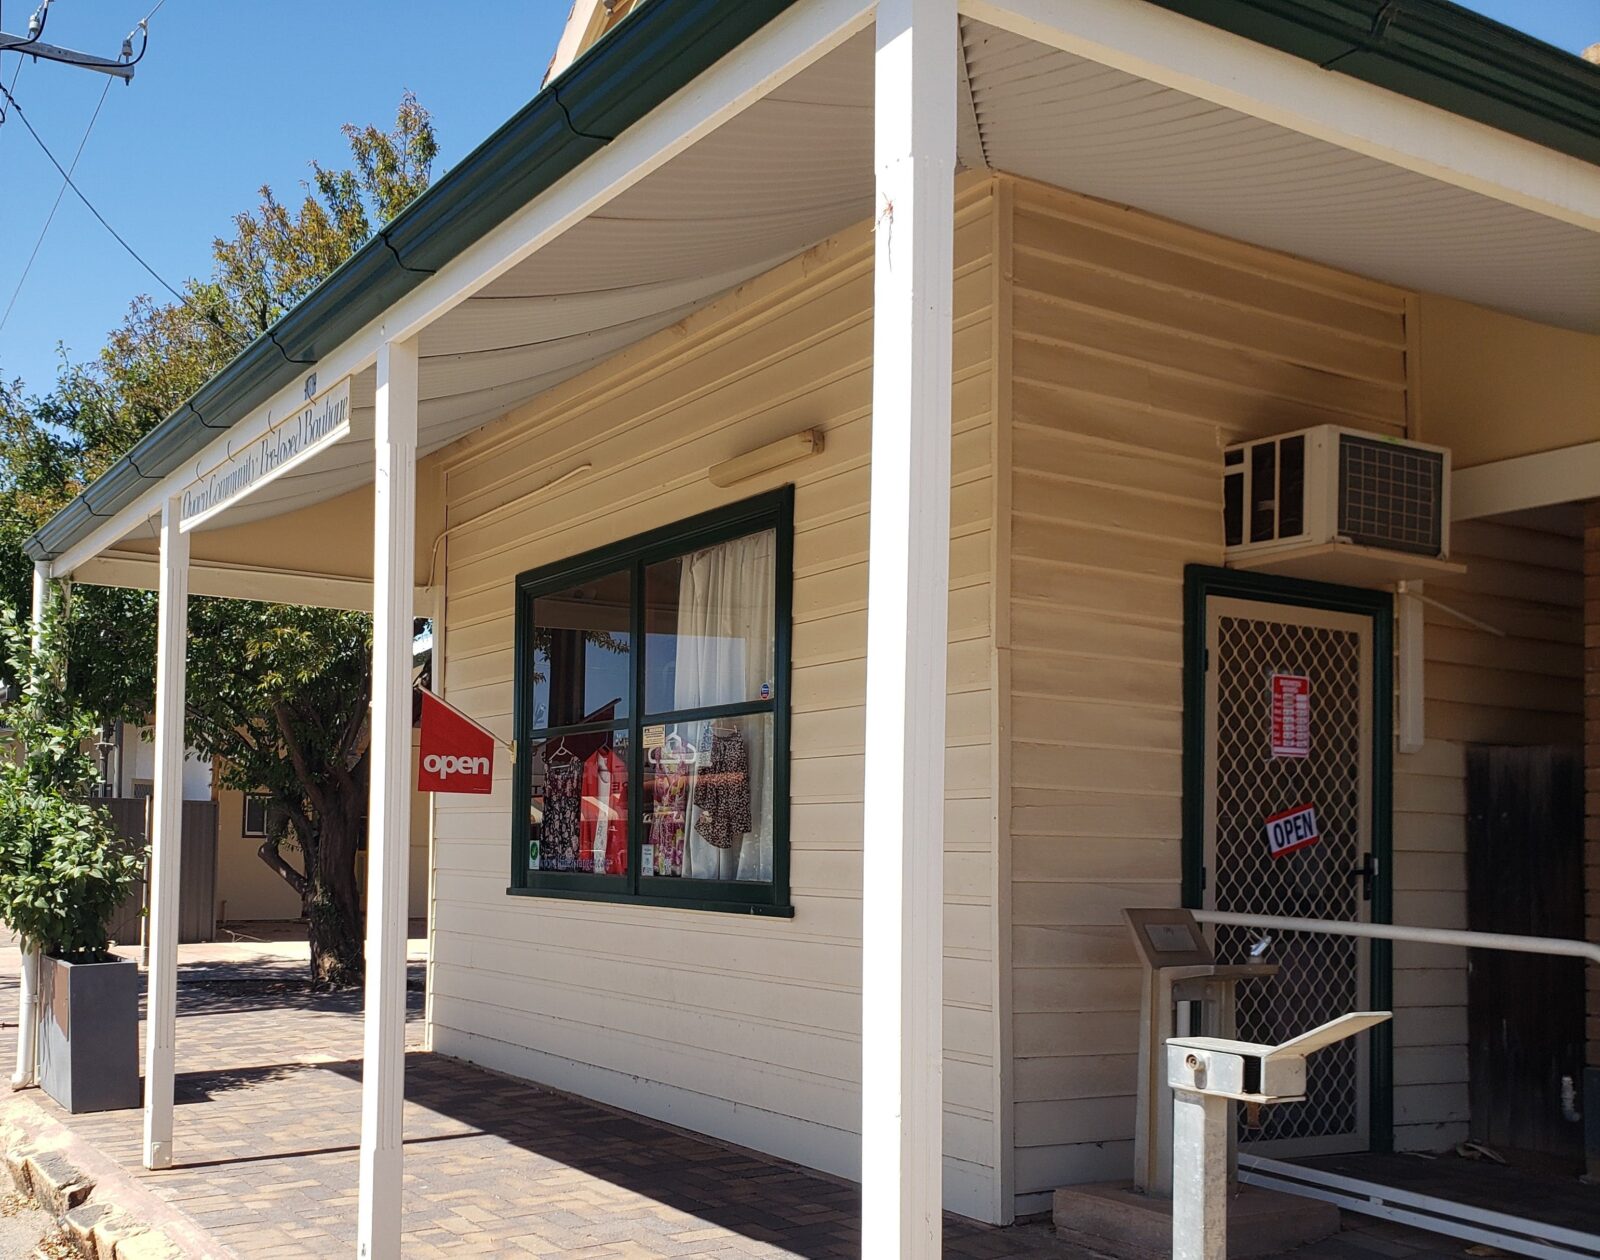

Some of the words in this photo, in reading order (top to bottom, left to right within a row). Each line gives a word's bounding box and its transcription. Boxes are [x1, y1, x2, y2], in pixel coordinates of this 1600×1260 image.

[304, 394, 348, 445] Boutique
[423, 754, 490, 780] open
[1273, 811, 1314, 848] OPEN
